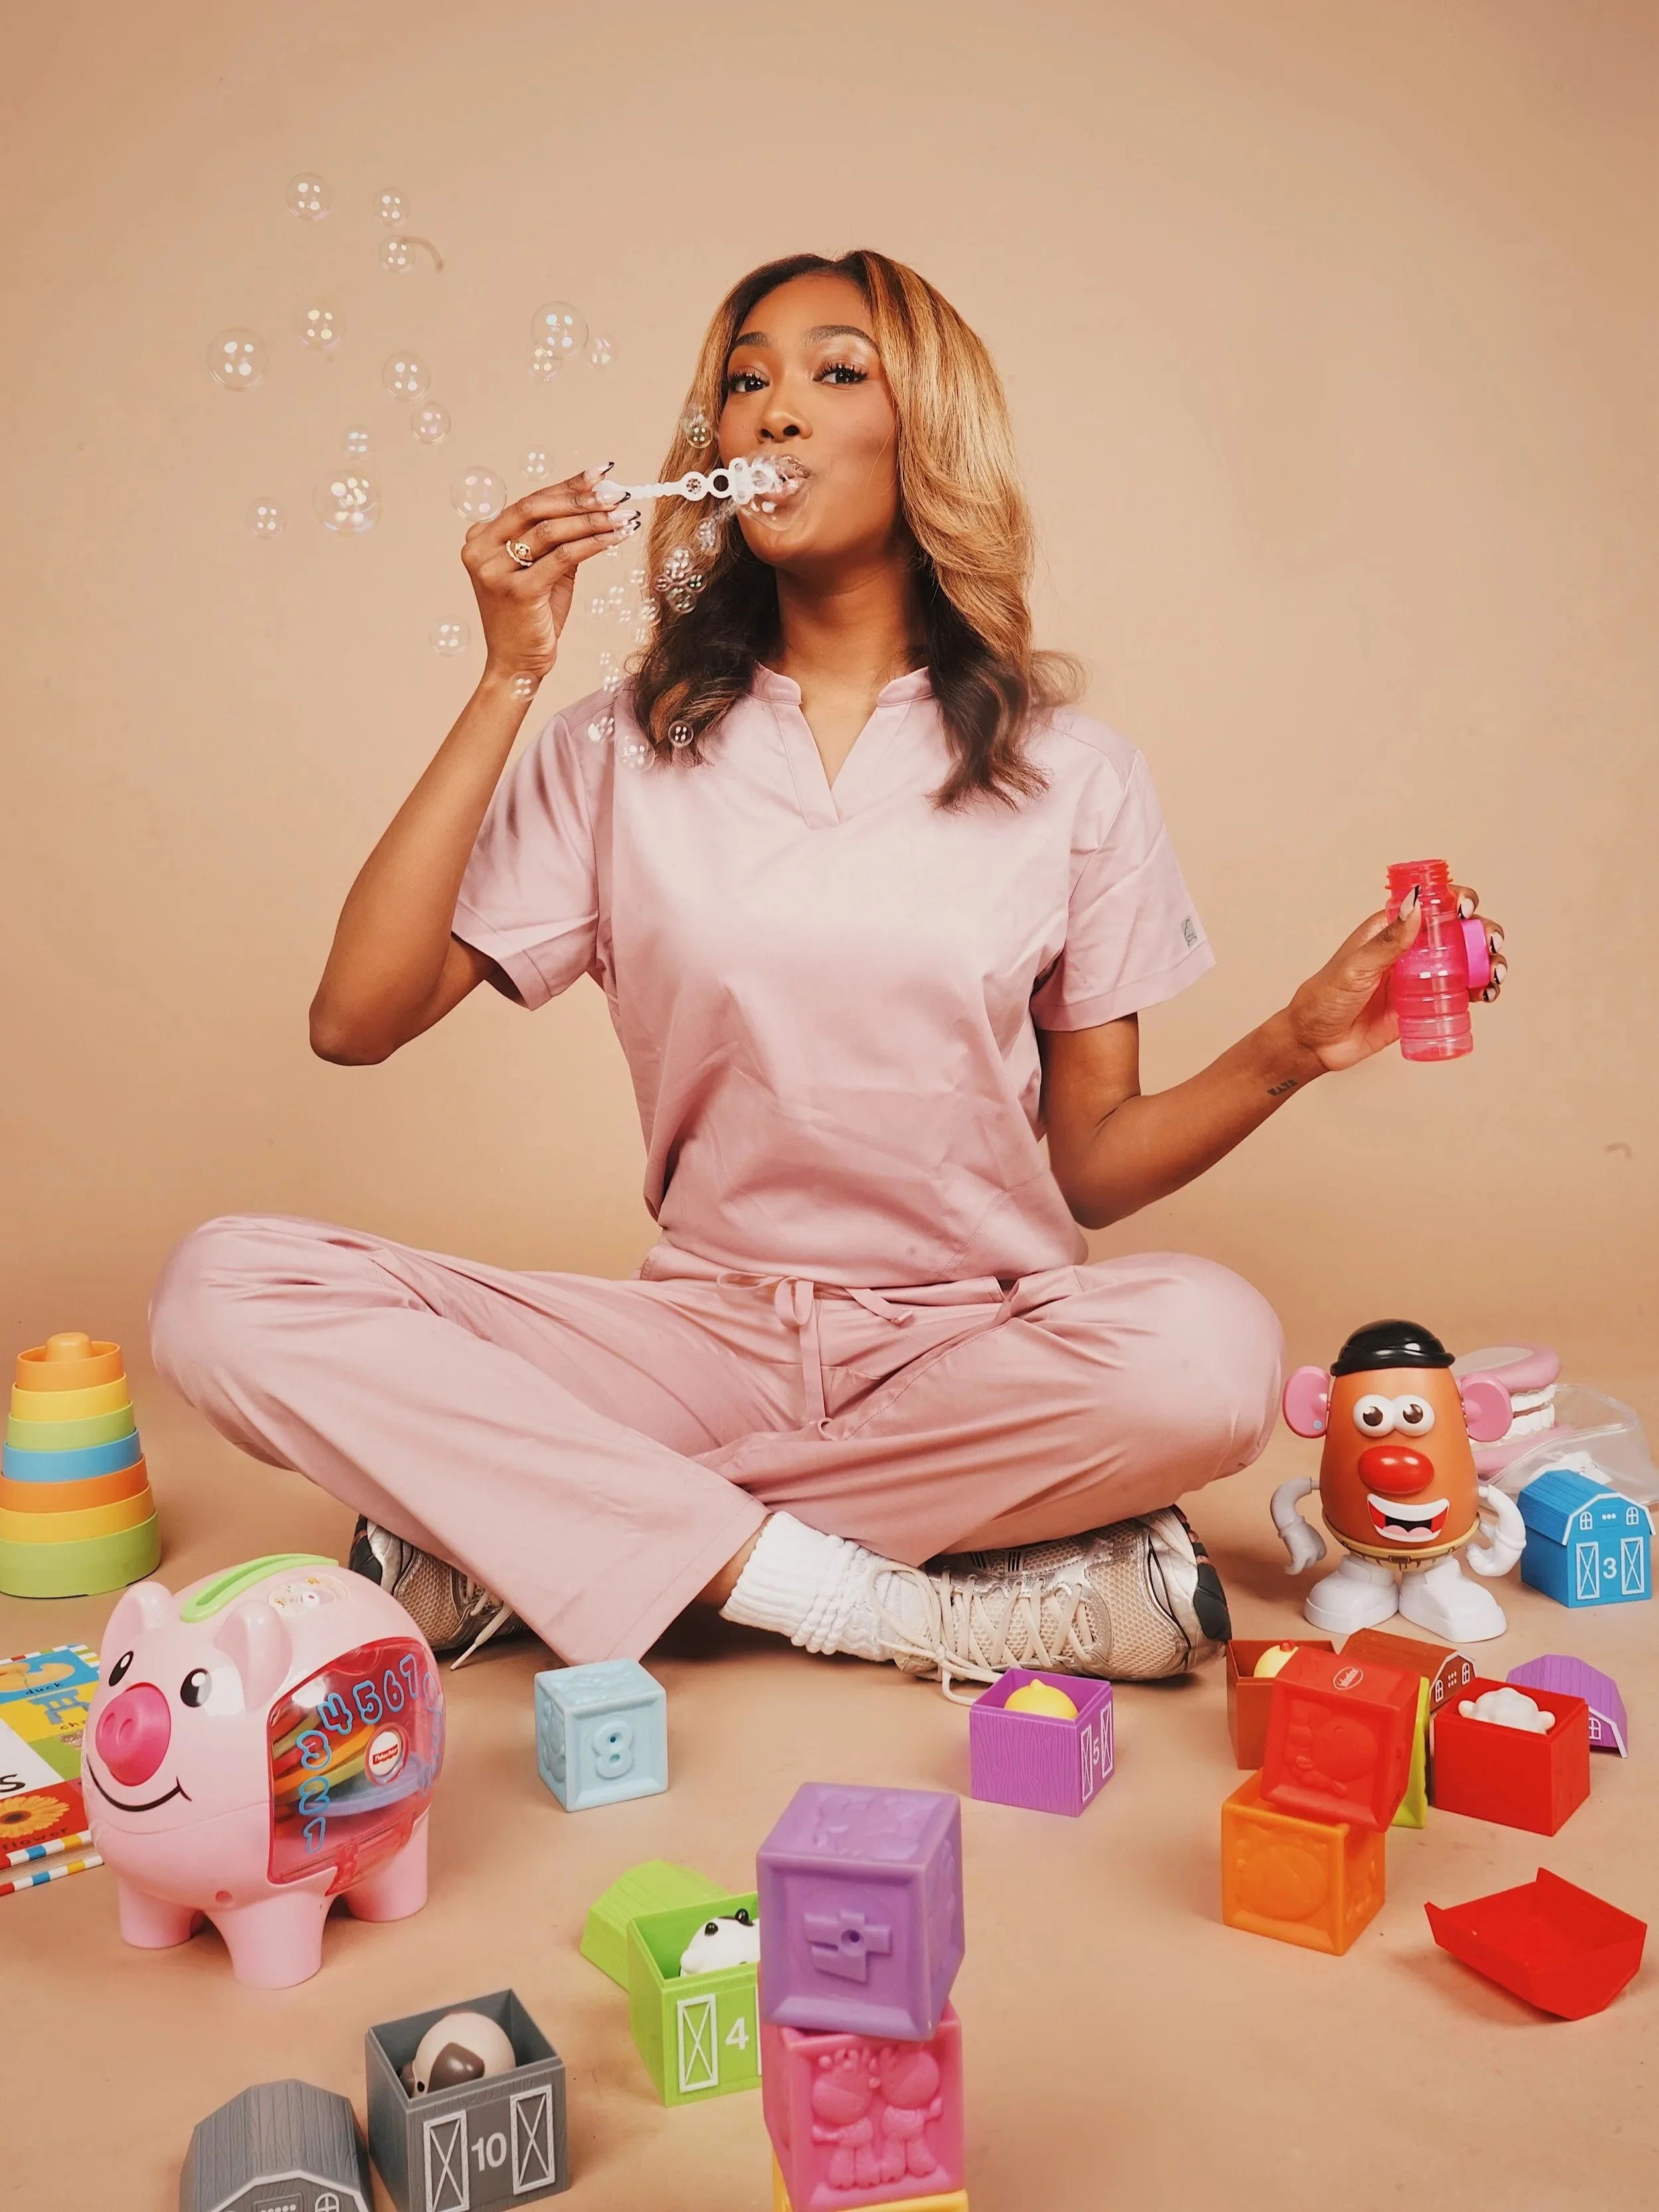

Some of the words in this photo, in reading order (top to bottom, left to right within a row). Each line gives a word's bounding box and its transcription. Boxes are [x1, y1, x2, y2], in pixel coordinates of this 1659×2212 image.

[1602, 1556, 1617, 1579] 3
[25, 1682, 64, 1695] duck
[383, 1670, 404, 1712] 6
[399, 1653, 418, 1698] 7
[317, 1692, 353, 1735] 4
[353, 1680, 382, 1724] 5
[296, 1730, 331, 1770] 3
[592, 1720, 635, 1779] 8
[1093, 1736, 1100, 1766] 5
[298, 1775, 331, 1815] 2
[2, 1827, 67, 1850] flower
[303, 1817, 326, 1853] 1
[725, 2017, 750, 2050] 4
[471, 2132, 507, 2172] 10
